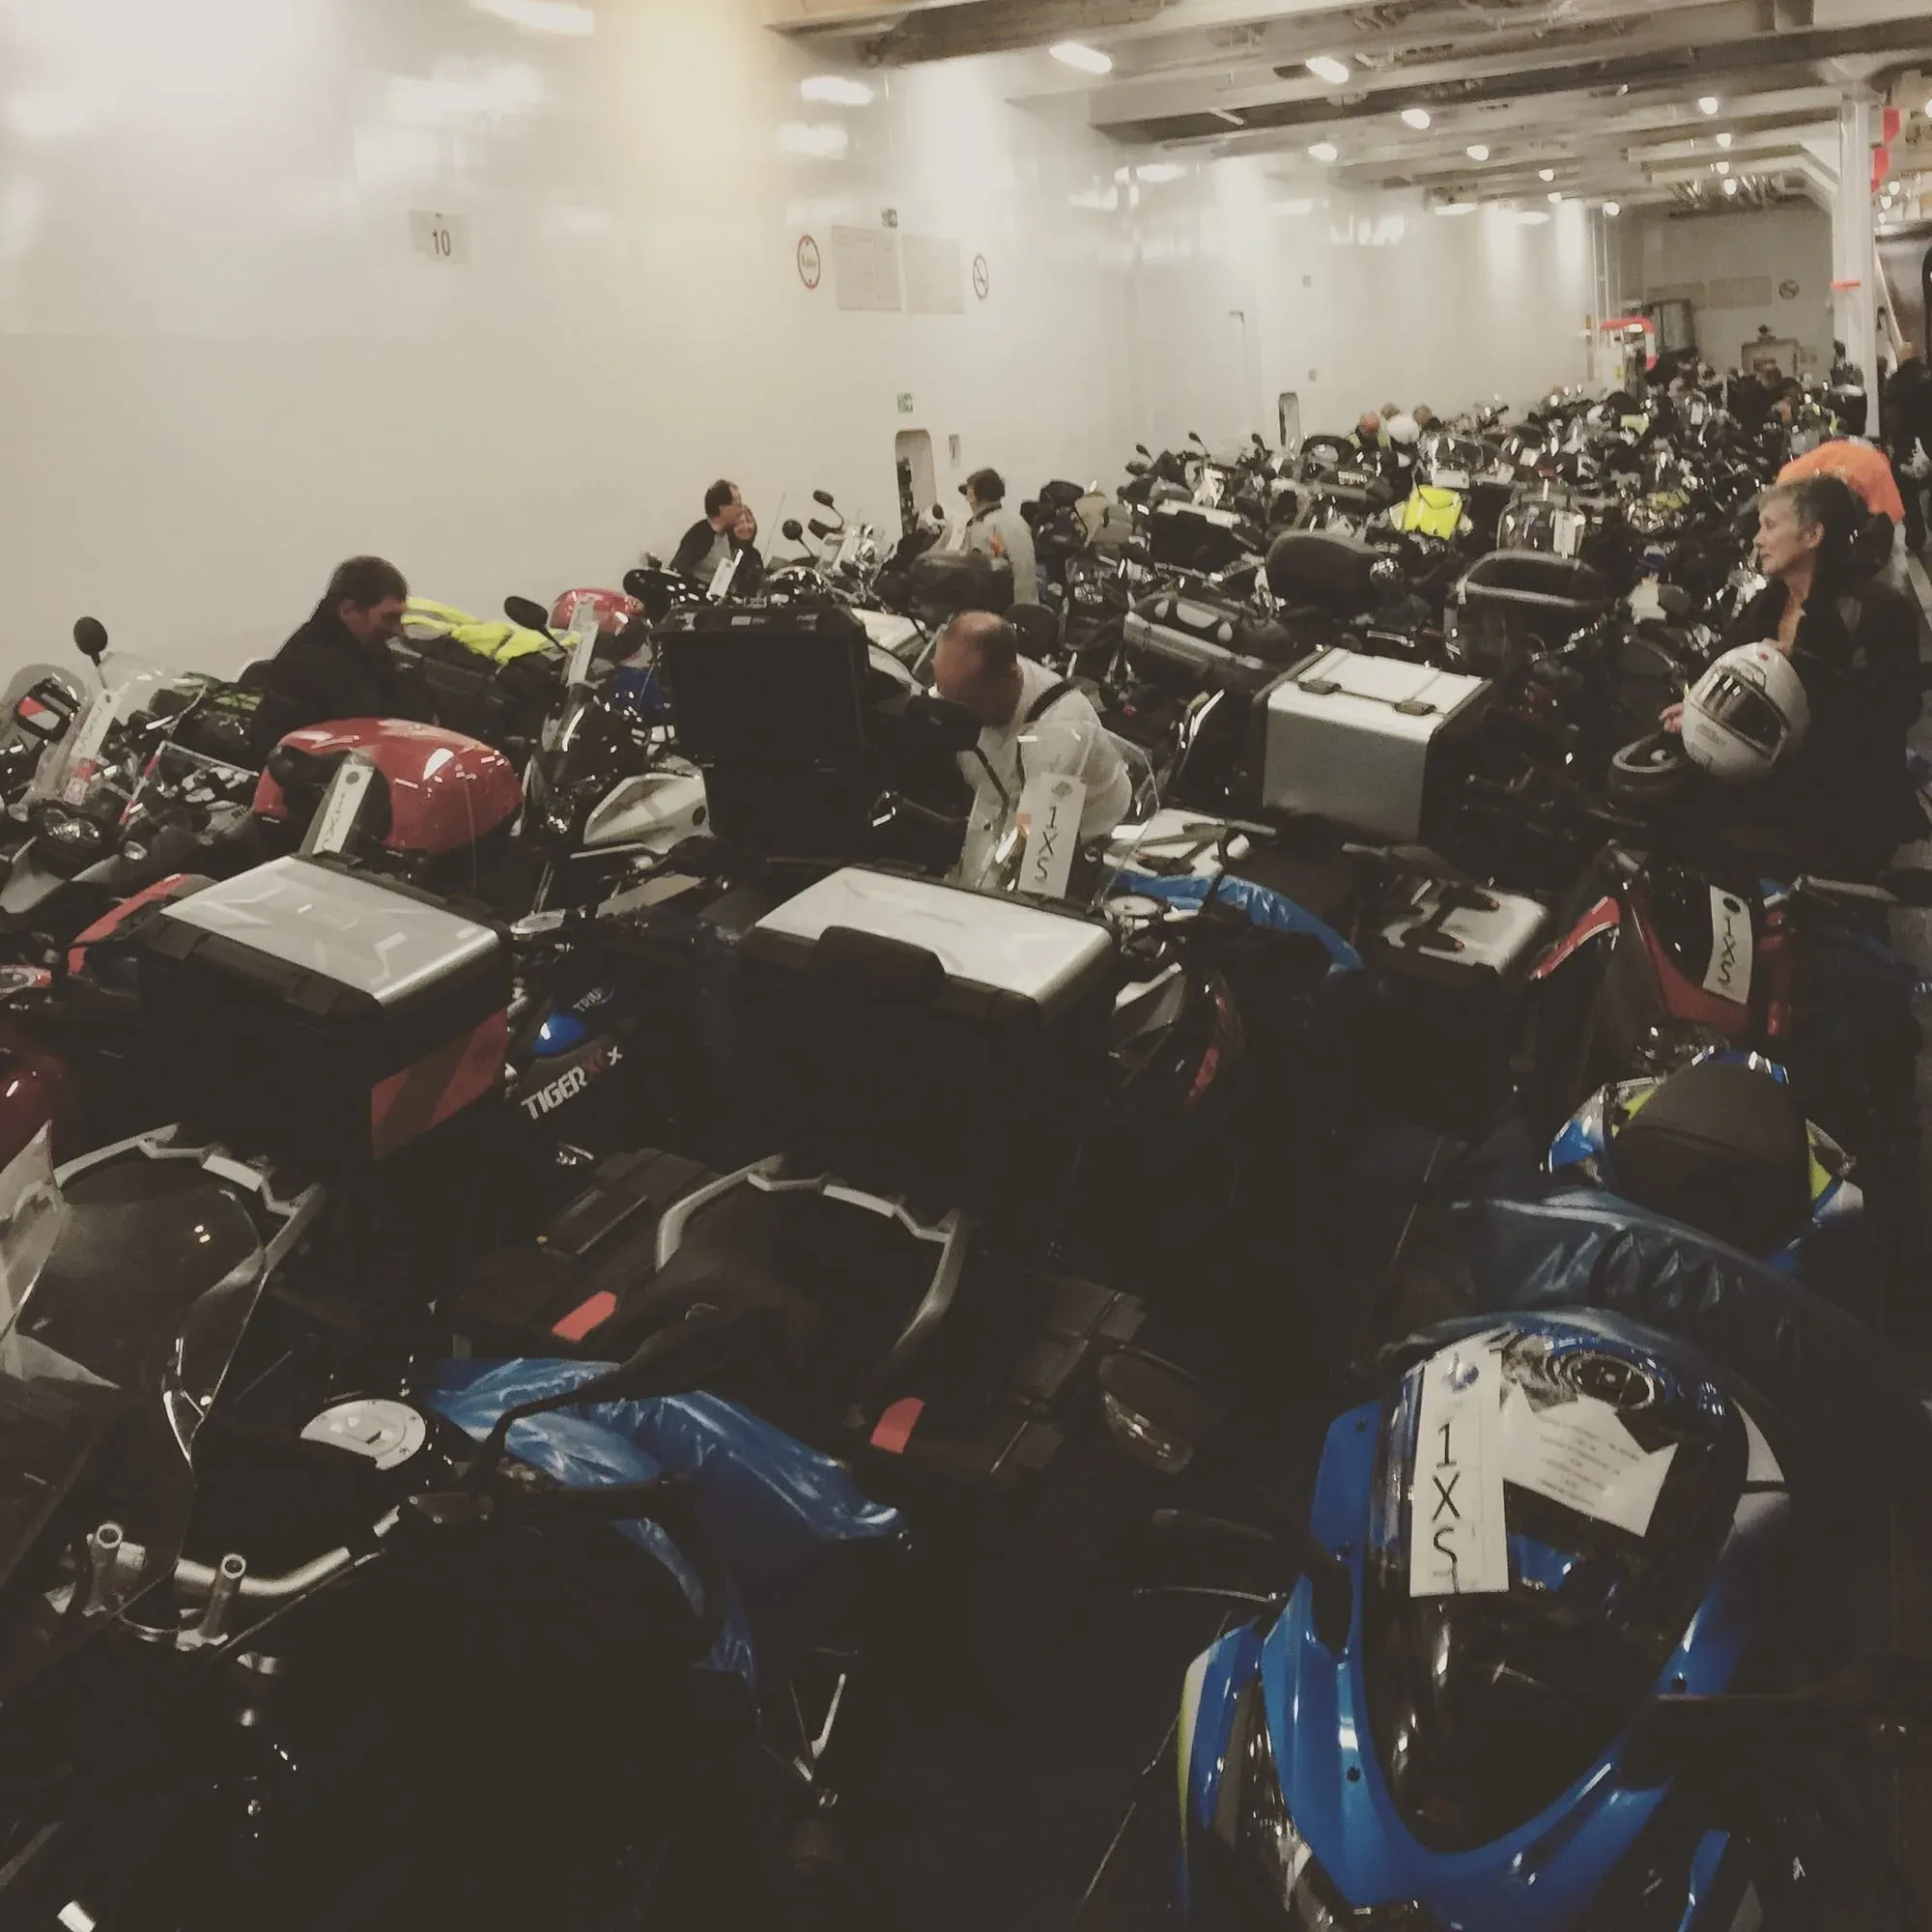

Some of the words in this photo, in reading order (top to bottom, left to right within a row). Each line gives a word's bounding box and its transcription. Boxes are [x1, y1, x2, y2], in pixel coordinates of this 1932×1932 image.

[431, 228, 451, 256] 10
[1034, 805, 1060, 883] 1XS
[1717, 914, 1737, 985] 1XS
[521, 1065, 588, 1120] TIGER
[1433, 1422, 1461, 1593] 1XS
